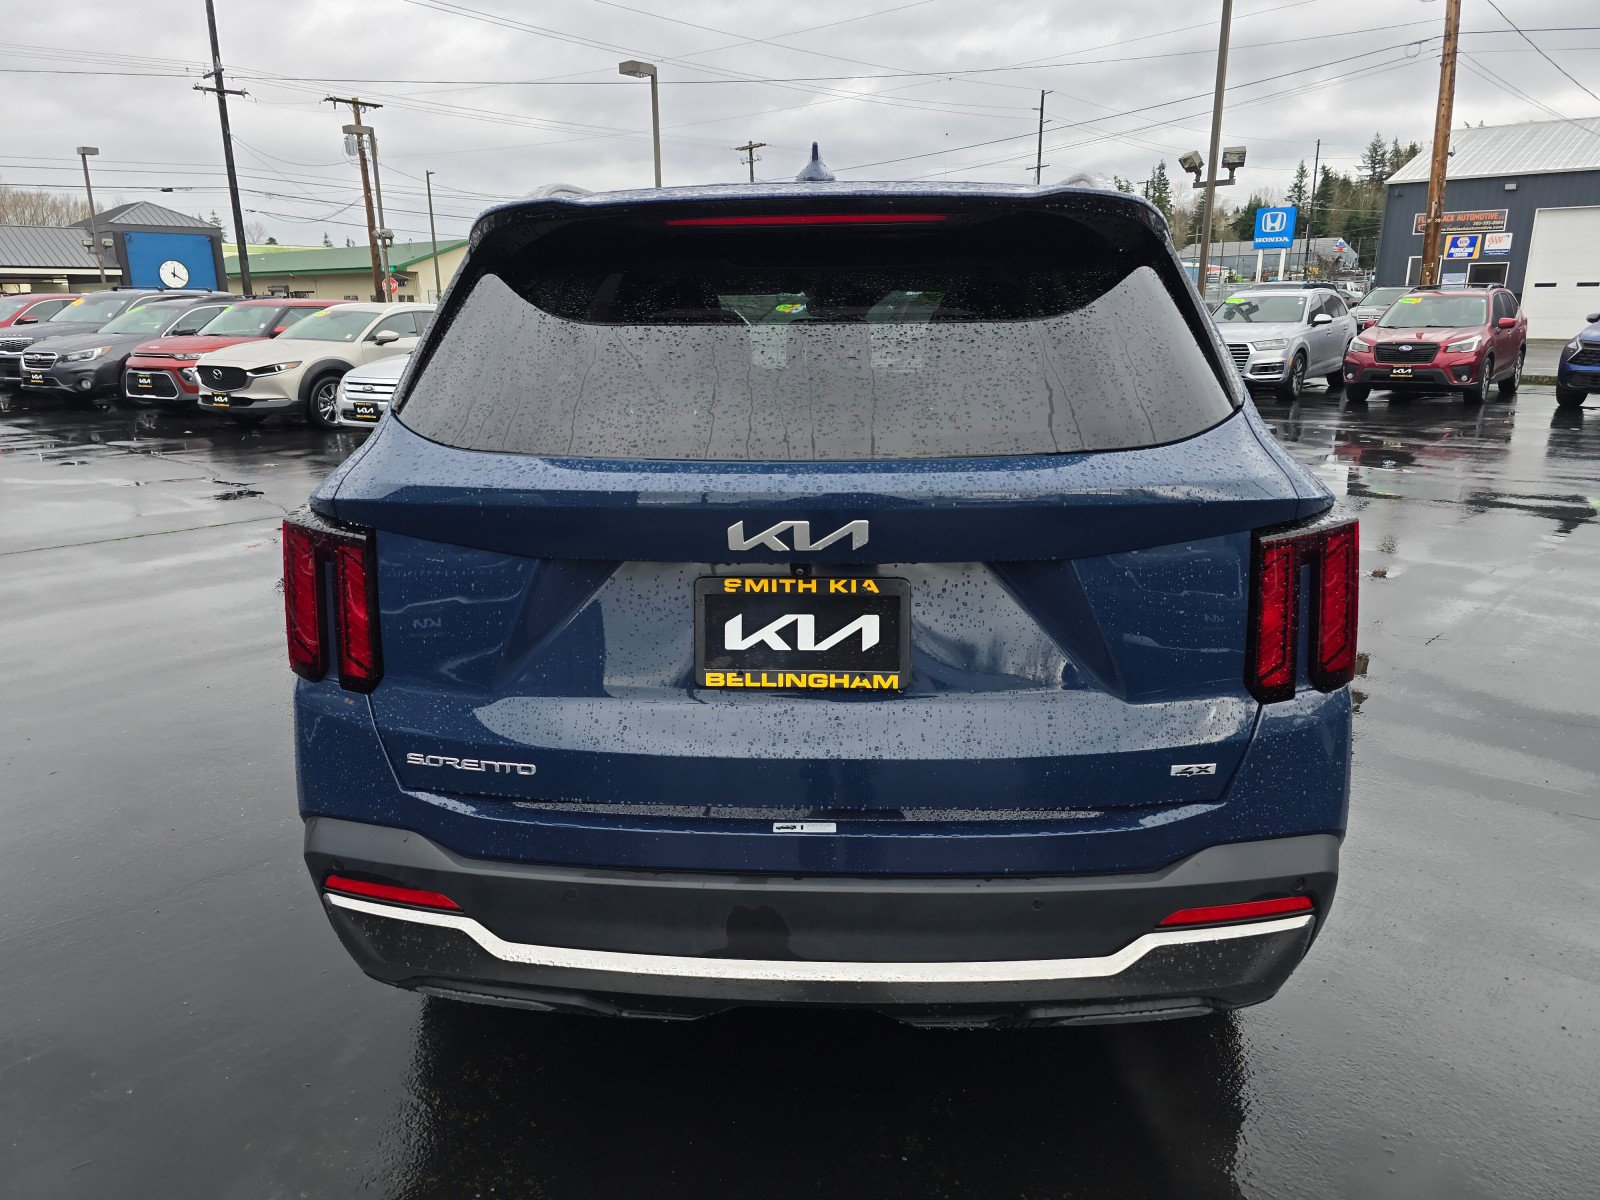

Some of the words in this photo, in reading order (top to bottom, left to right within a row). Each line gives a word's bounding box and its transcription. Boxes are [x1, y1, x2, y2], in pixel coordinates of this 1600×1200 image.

[1456, 213, 1499, 222] AUTOMOTIVE
[727, 520, 869, 551] KIA
[723, 578, 817, 593] SMITH
[829, 579, 880, 594] KIA
[724, 613, 880, 652] KIA
[705, 672, 899, 690] BELLINGHAM
[406, 752, 537, 776] SORENTO
